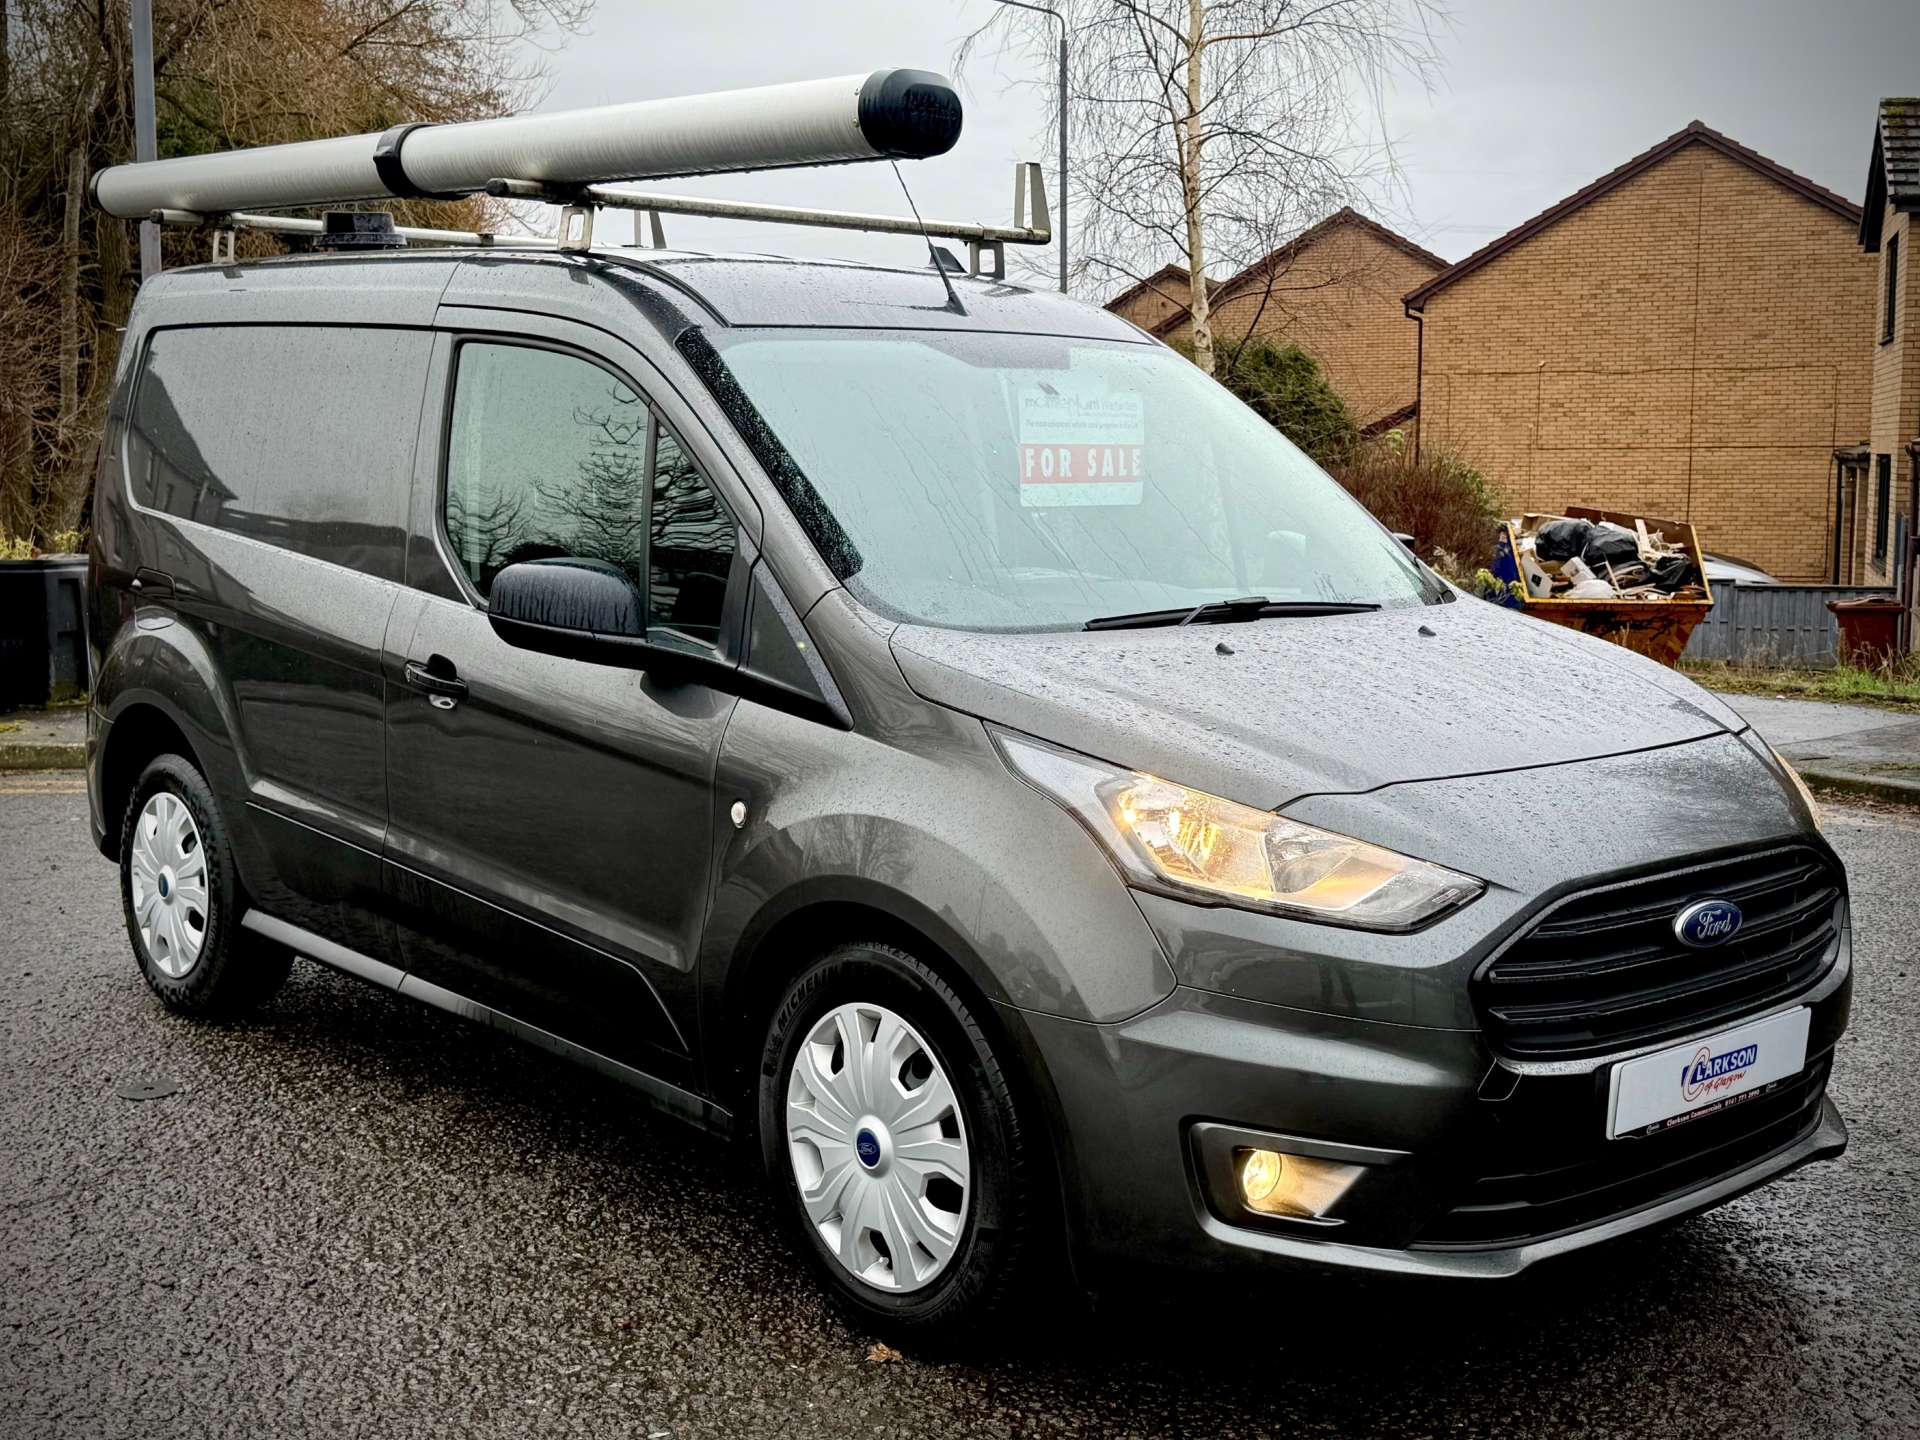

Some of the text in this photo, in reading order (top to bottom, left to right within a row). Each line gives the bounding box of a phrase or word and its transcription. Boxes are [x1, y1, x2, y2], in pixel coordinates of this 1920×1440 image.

[1024, 447, 1142, 480] FOR SALE
[1696, 909, 1732, 939] Ford
[1682, 1046, 1757, 1102] CLARKSON
